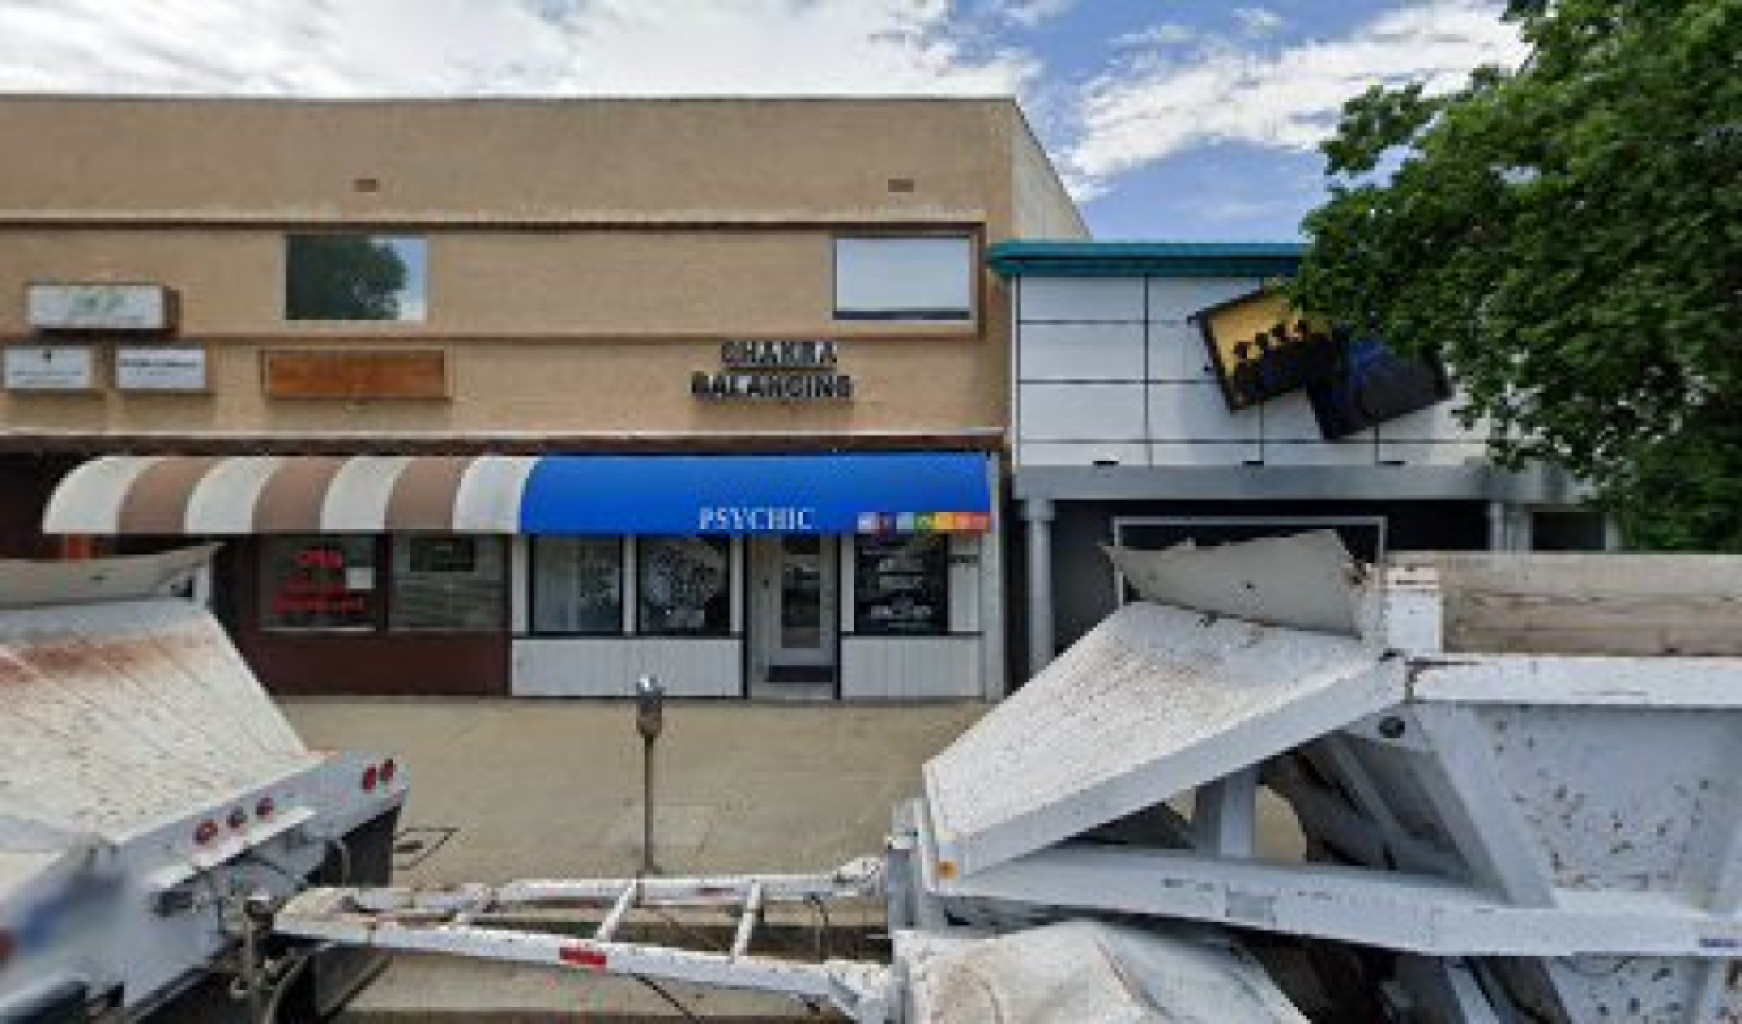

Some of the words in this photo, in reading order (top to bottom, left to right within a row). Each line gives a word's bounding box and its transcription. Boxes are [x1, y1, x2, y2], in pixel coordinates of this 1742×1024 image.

[721, 341, 838, 368] CHAKRA
[690, 372, 854, 401] BALANCING
[698, 507, 816, 530] PSYCHIC
